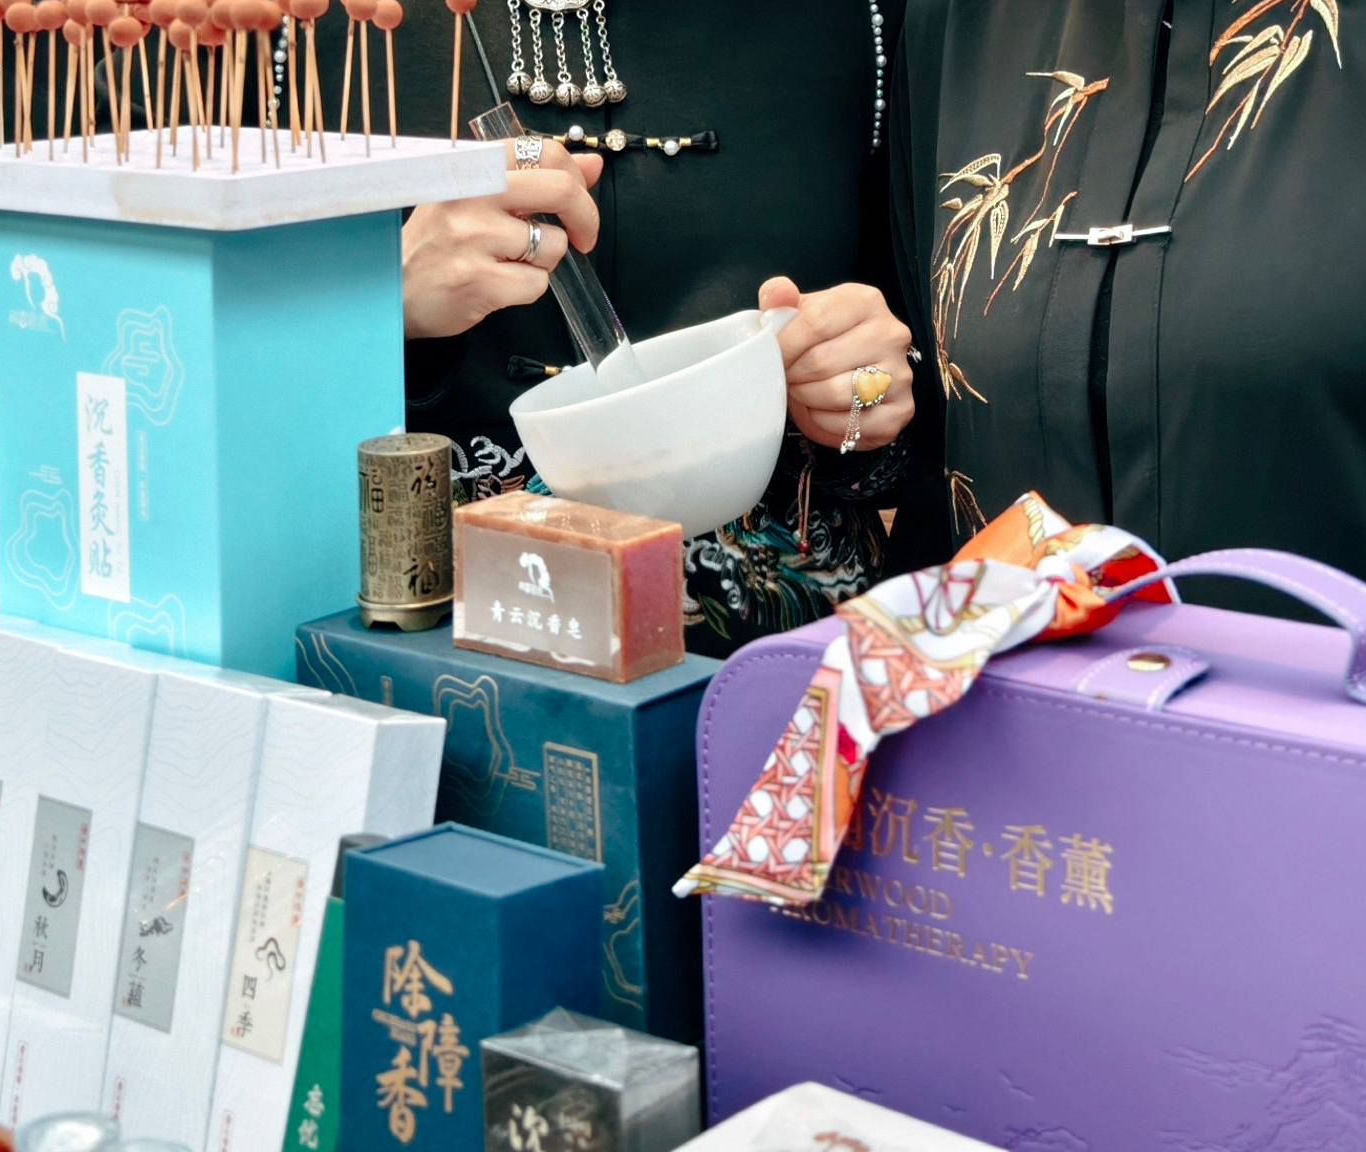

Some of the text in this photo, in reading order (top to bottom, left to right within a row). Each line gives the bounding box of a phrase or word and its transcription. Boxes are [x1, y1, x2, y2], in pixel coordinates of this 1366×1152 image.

[490, 599, 583, 640] 青云沉香皂
[375, 939, 471, 1143] 除障香
